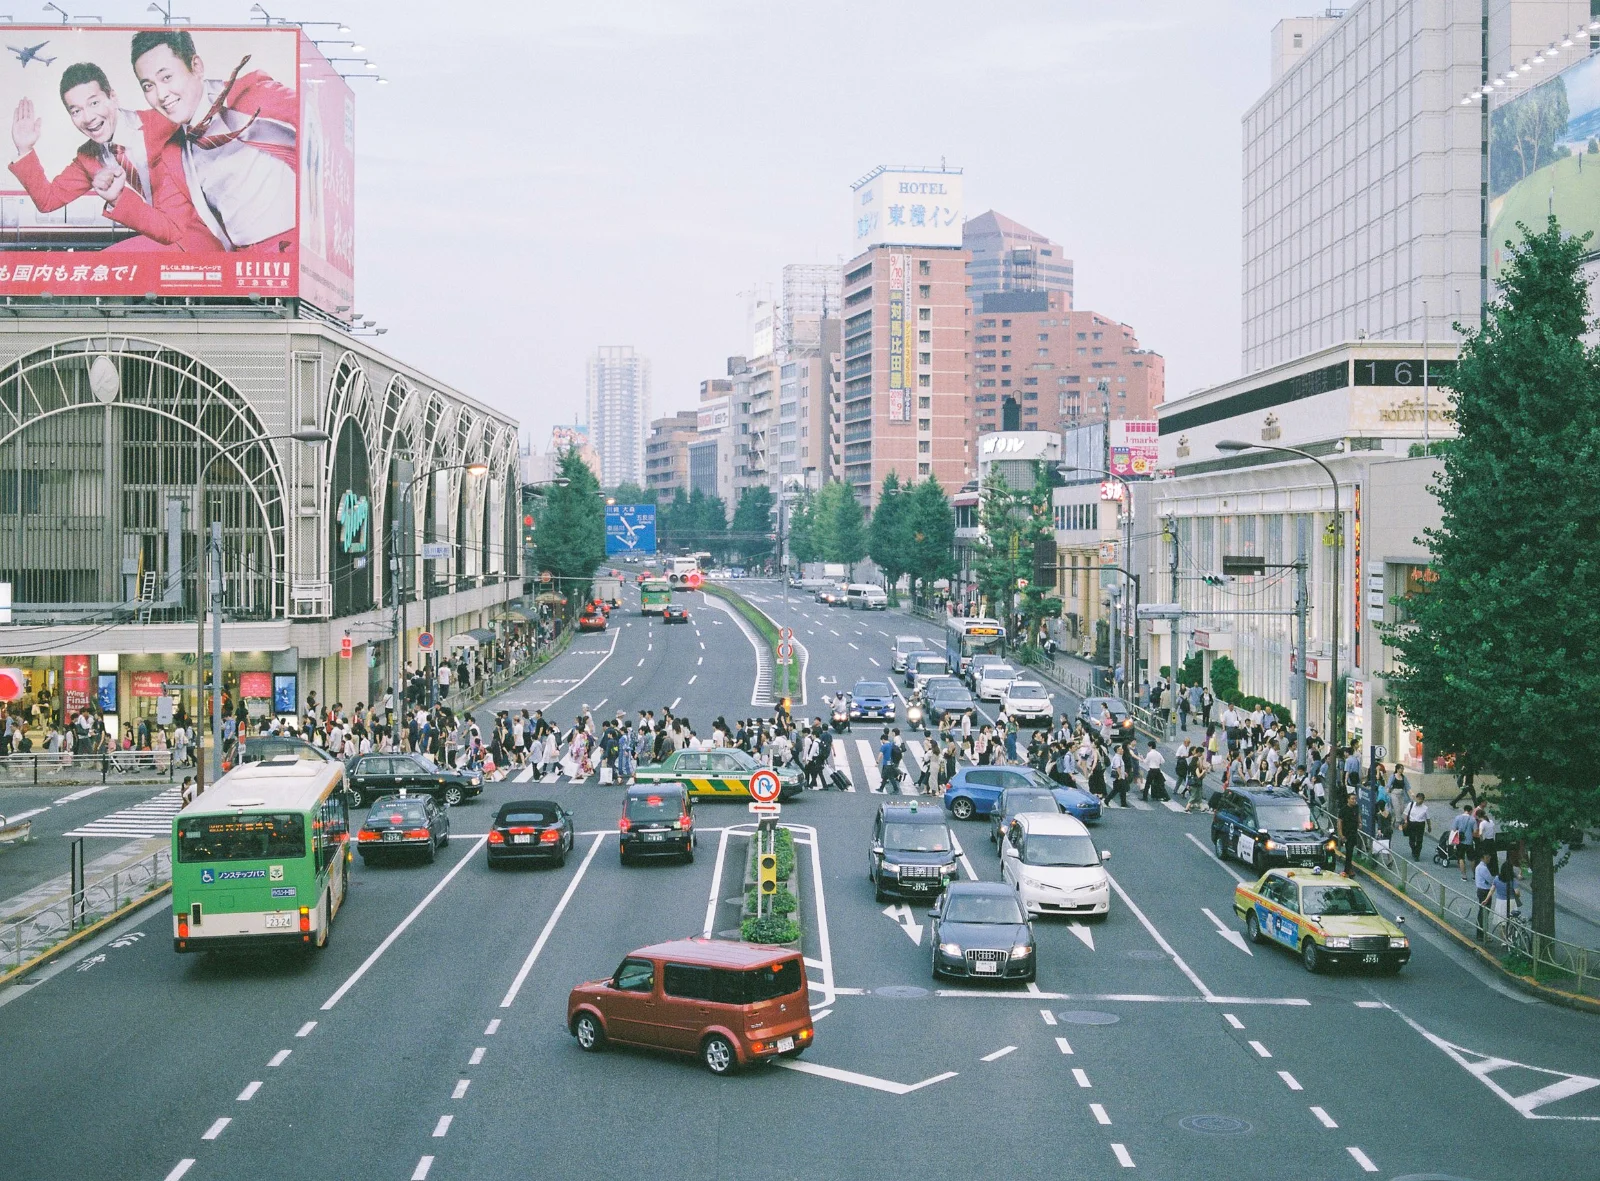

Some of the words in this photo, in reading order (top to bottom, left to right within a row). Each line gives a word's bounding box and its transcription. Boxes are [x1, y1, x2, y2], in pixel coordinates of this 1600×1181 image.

[899, 182, 947, 195] HOTEL
[888, 203, 959, 228] 東横イン
[235, 261, 290, 276] KEIKYU
[66, 690, 85, 698] Wing
[66, 696, 90, 704] Final
[219, 870, 265, 879] ノンステップバス
